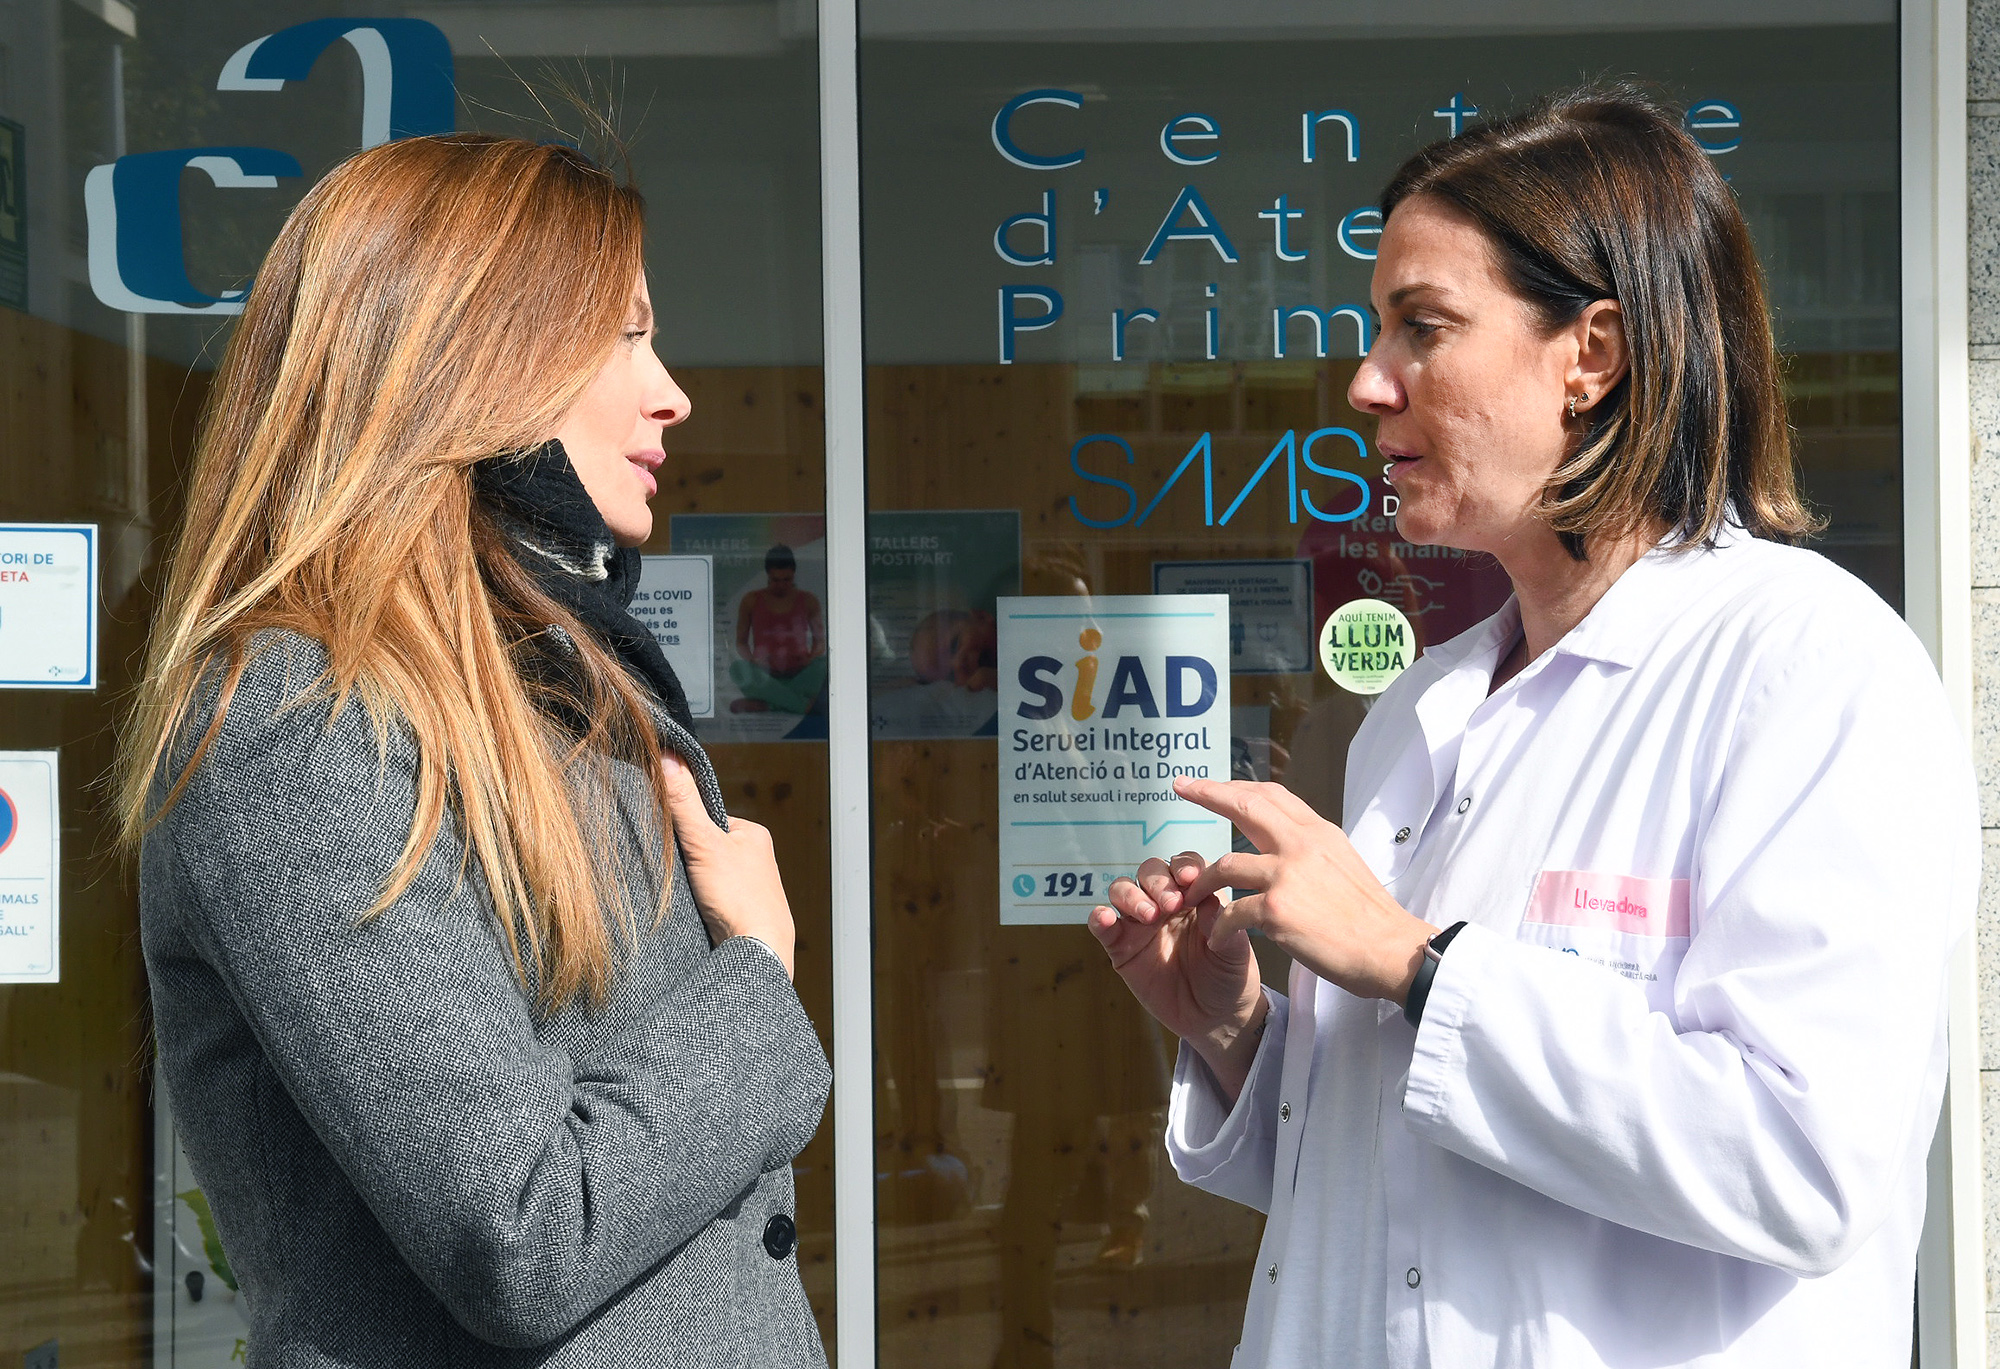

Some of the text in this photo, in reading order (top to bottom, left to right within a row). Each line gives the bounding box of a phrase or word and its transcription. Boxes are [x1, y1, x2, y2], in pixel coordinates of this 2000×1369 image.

[991, 88, 1742, 170] Cente
[993, 186, 1384, 265] d’Ate
[998, 283, 1371, 365] Prim
[683, 538, 749, 551] TALLERS
[872, 536, 939, 550] TALLERS
[1339, 534, 1379, 558] les
[0, 553, 54, 565] ORI DE
[872, 552, 953, 566] POSTPART
[0, 571, 29, 582] ETA
[633, 590, 692, 600] ats COVID
[627, 606, 673, 617] opeu es
[1366, 613, 1396, 622] TENIM
[646, 619, 678, 629] és de
[1329, 624, 1404, 648] LLUM
[1331, 651, 1405, 672] VERDA
[1013, 727, 1211, 758] Servei Integral
[1113, 765, 1125, 779] a
[1132, 762, 1150, 779] la
[1157, 762, 1208, 779] Dona
[1014, 792, 1029, 803] en
[1033, 790, 1067, 803] salut
[1070, 790, 1114, 803] sexual
[1117, 790, 1121, 802] i
[1044, 872, 1094, 897] 191
[0, 893, 39, 904] MALS
[1573, 887, 1648, 918] Llevadora
